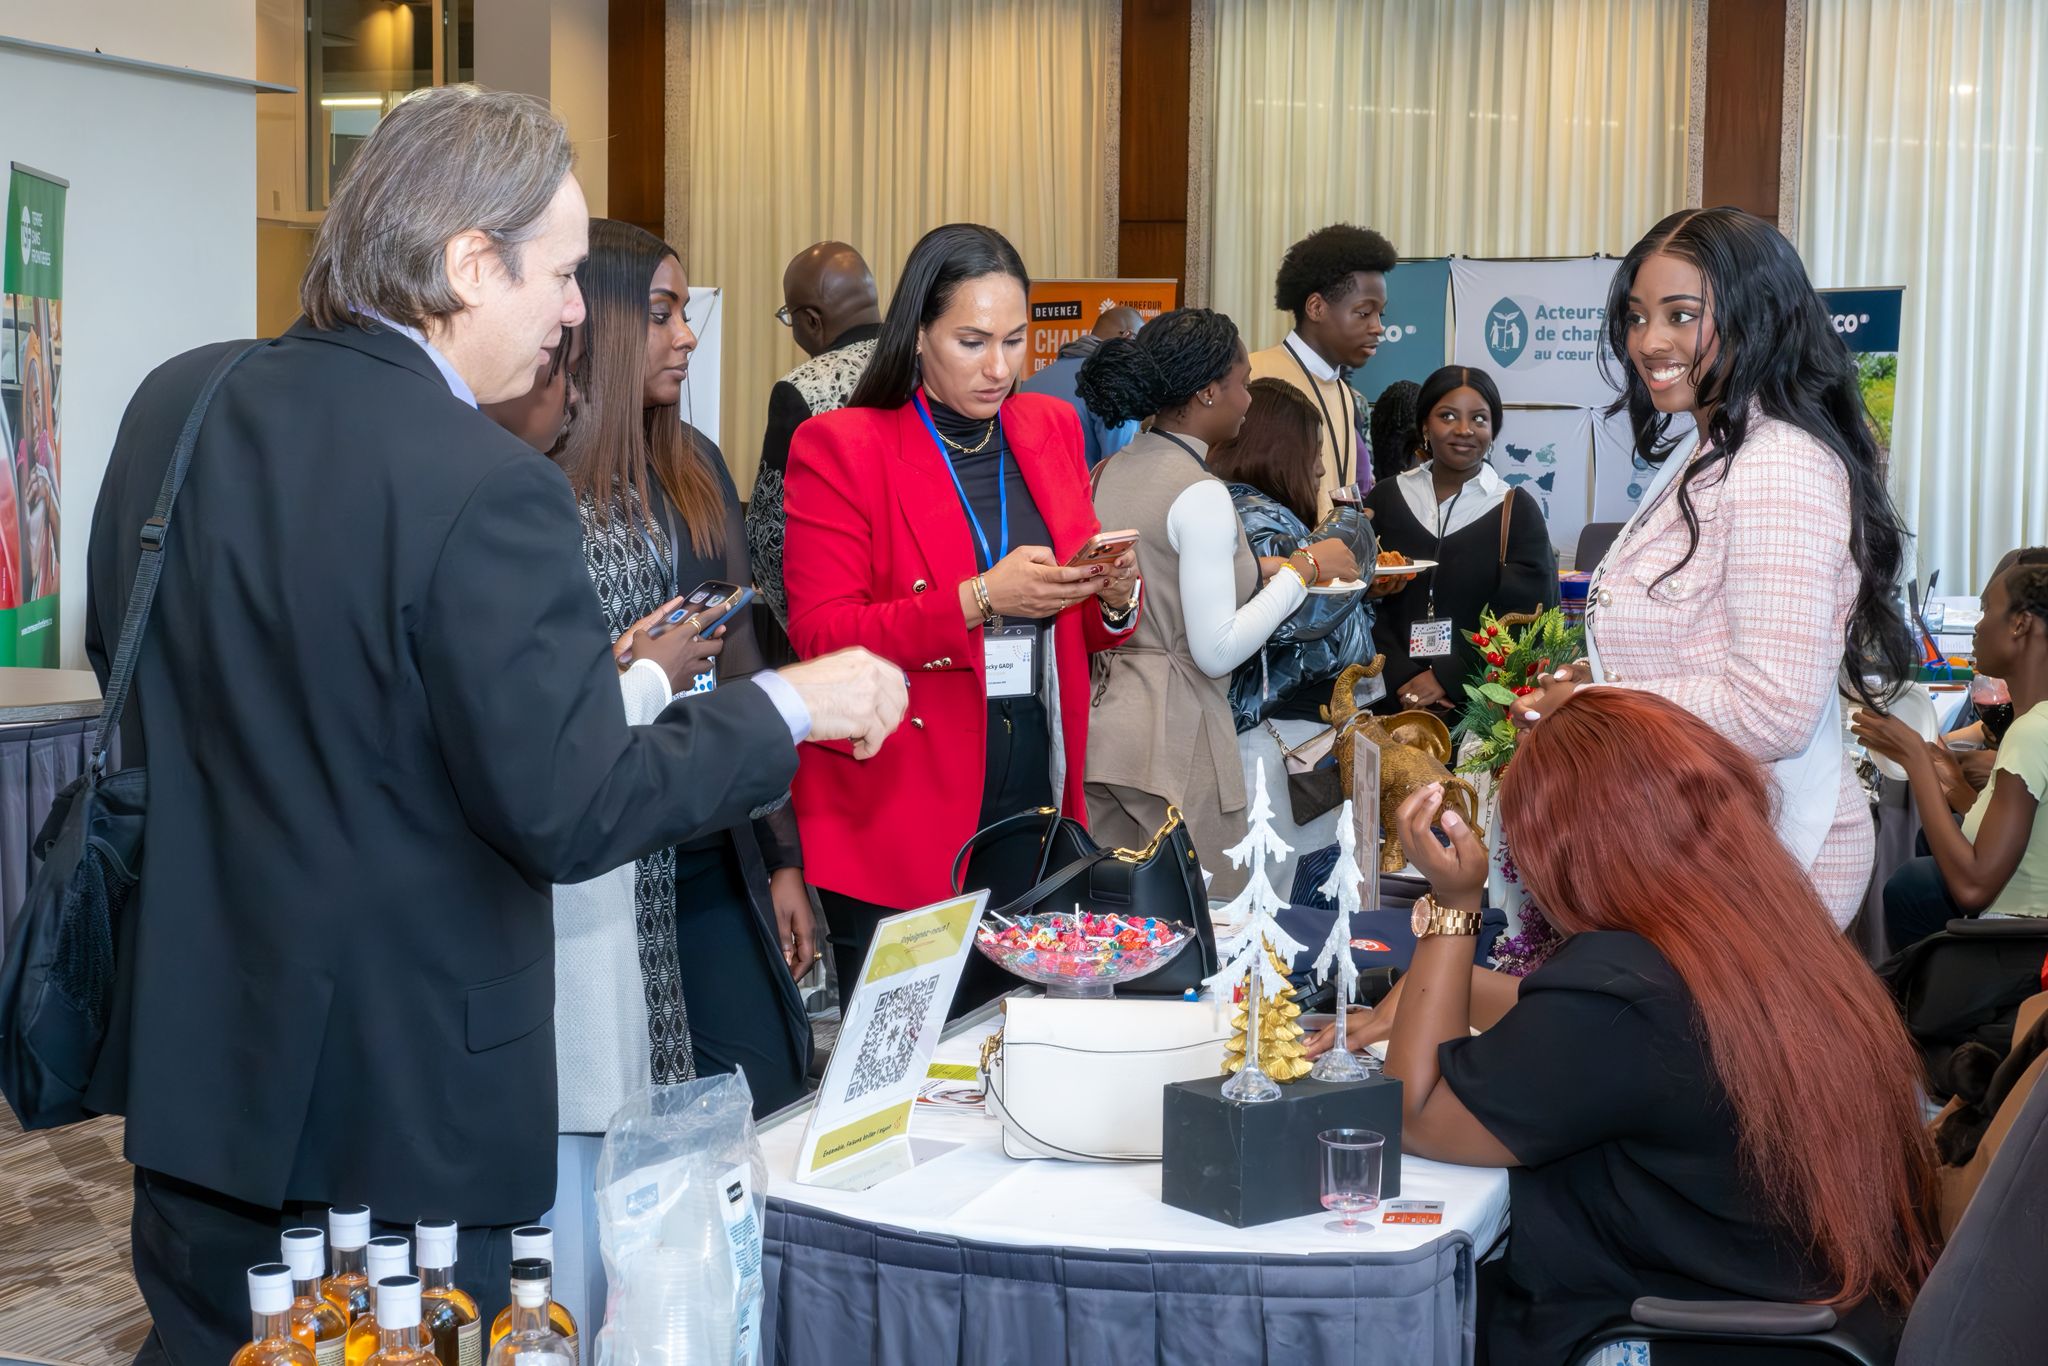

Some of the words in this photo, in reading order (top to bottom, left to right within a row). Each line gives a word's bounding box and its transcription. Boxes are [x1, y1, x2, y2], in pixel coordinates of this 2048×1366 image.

[1035, 305, 1078, 318] DEVENEZ
[1535, 304, 1605, 320] Acteurs
[1535, 326, 1556, 341] de
[1534, 350, 1552, 360] au
[1557, 350, 1594, 360] cœur
